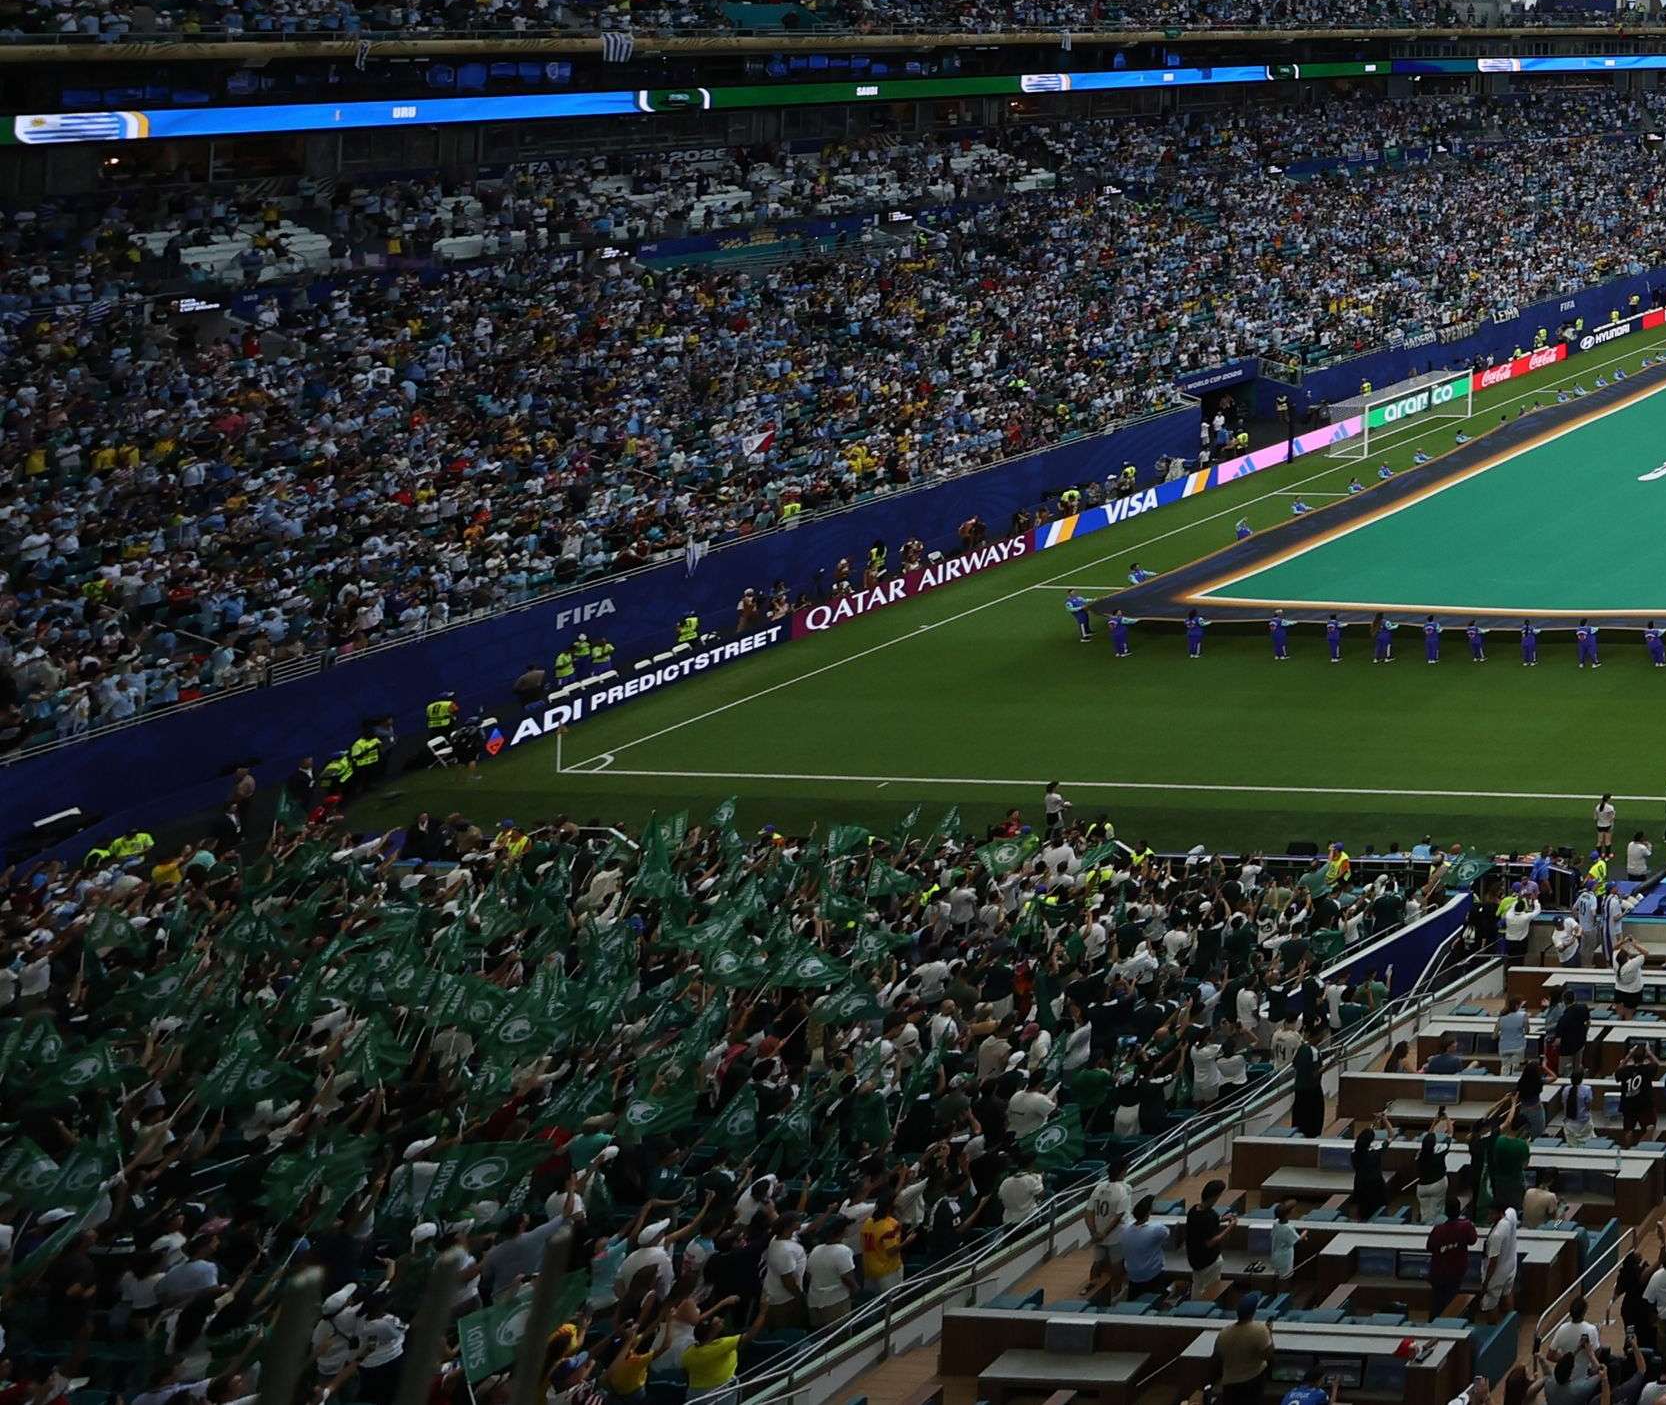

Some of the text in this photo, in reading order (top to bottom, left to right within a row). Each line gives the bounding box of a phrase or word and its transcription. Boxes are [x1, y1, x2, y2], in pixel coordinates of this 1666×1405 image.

[1560, 300, 1576, 312] FIFA
[1595, 323, 1631, 343] HYUNDAI
[1384, 385, 1453, 422] aramco
[1100, 487, 1159, 525] VISA
[805, 535, 1027, 631] QATAR AIRWAYS
[556, 598, 617, 631] FIFA
[509, 625, 782, 747] ADI PREDICTSTREET
[1626, 1075, 1643, 1091] 10
[1094, 1199, 1109, 1217] 10
